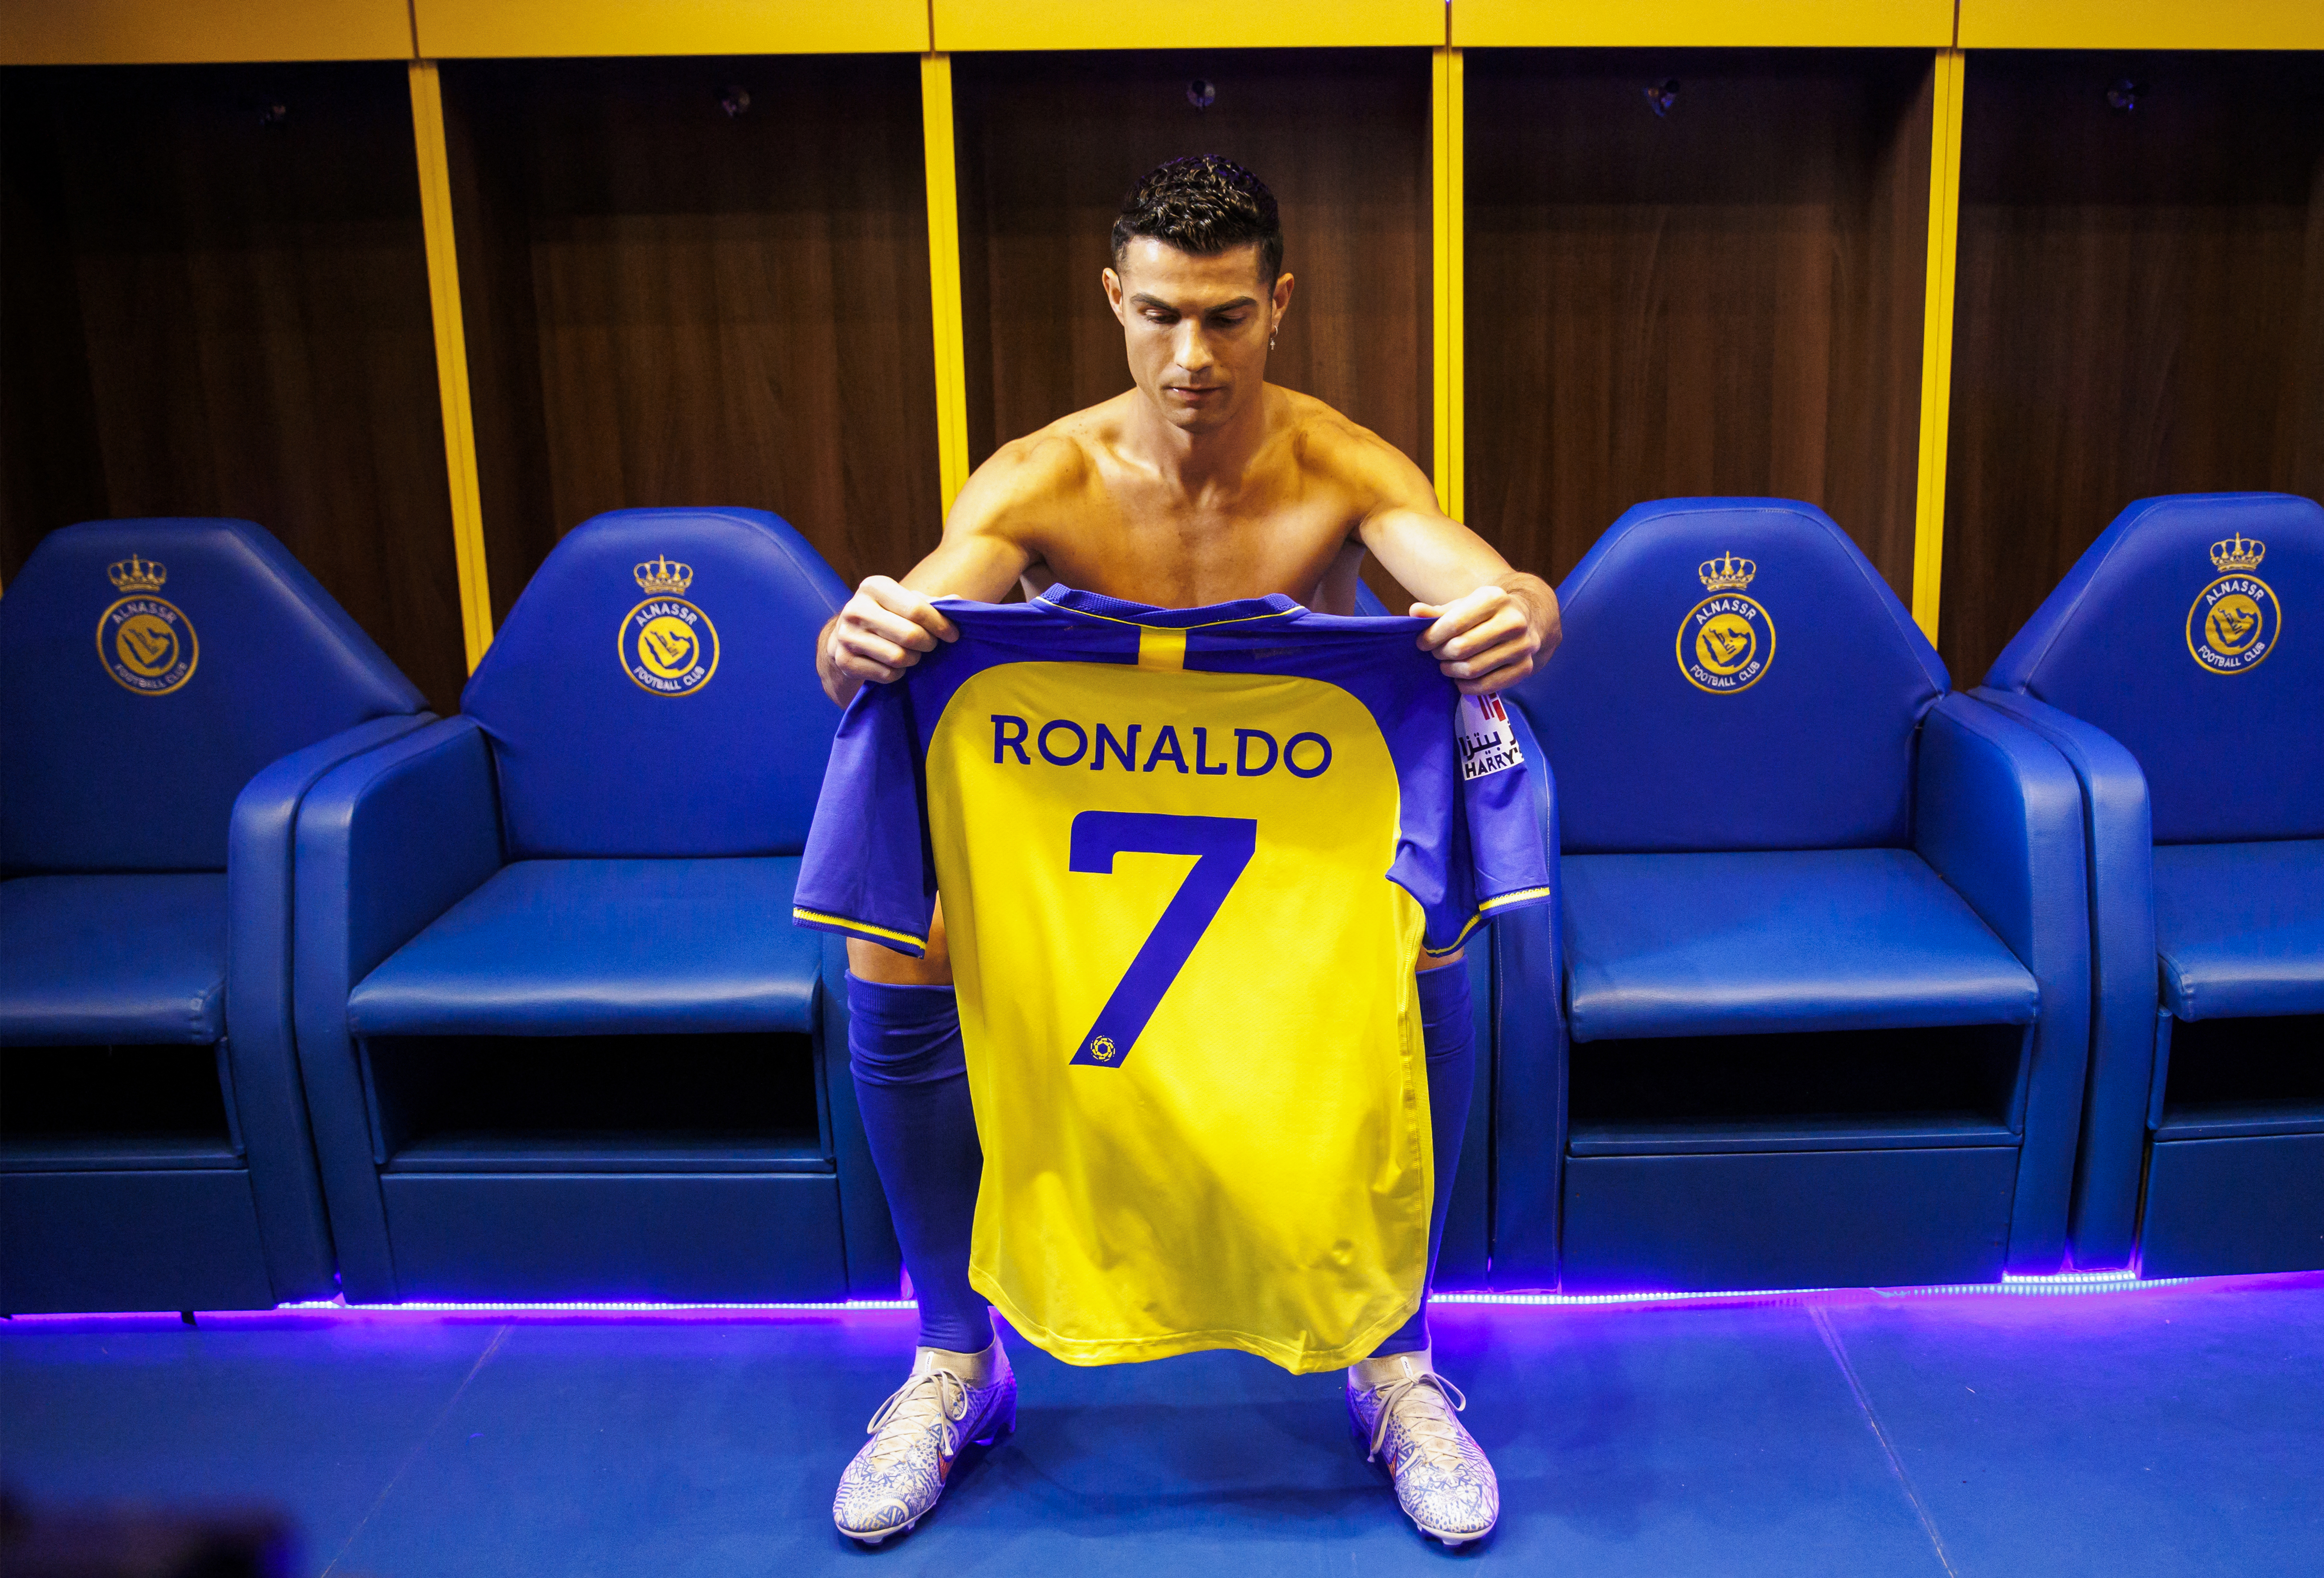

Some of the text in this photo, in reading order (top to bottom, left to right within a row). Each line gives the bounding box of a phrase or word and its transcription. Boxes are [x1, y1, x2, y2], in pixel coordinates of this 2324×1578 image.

[2206, 580, 2264, 605] ALNASSR
[635, 603, 698, 627] ALNASSR
[1696, 600, 1757, 624] ALNASSR
[2198, 642, 2265, 667] FOOTBALL CLUB
[634, 666, 705, 691] FOOTBALL CLUB
[1690, 661, 1760, 687] FOOTBALL CLUB
[991, 714, 1332, 779] RONALDO
[1465, 747, 1523, 778] HARRY'
[1069, 810, 1257, 1068] 7
